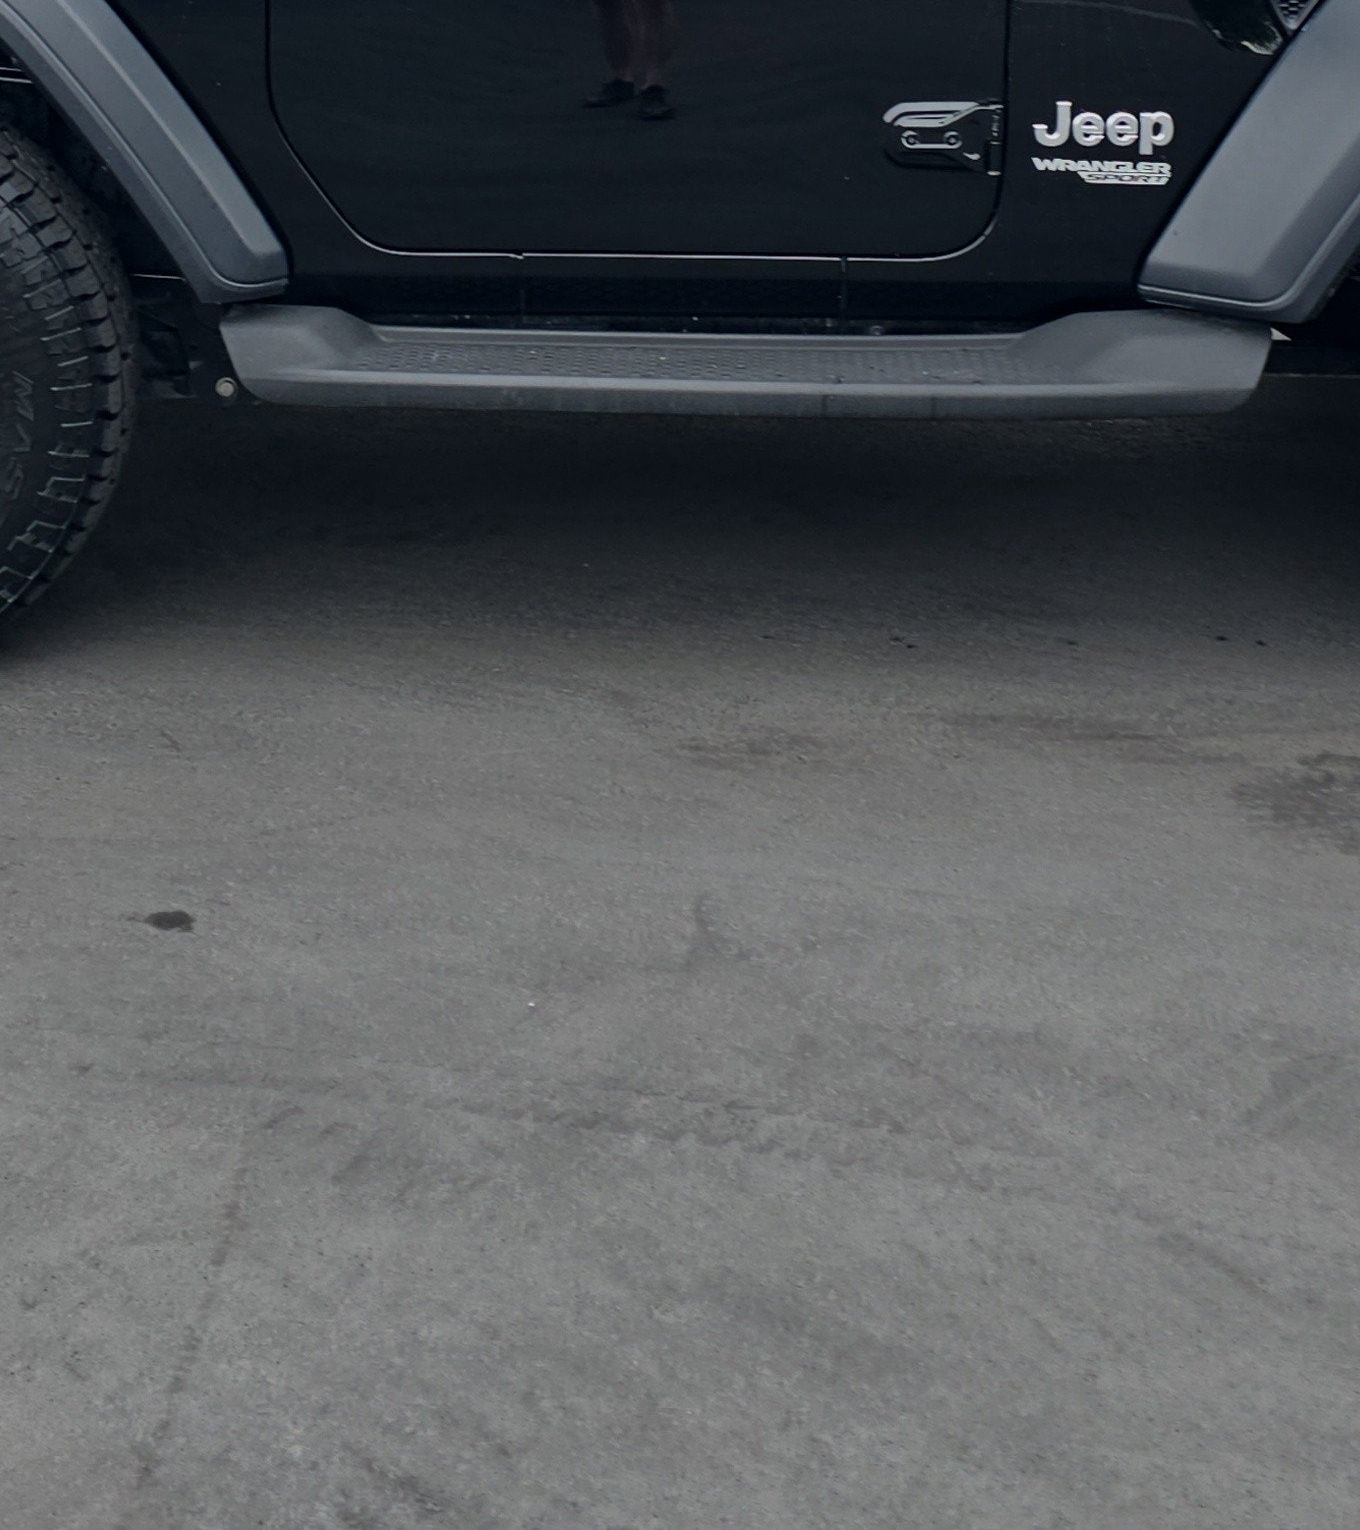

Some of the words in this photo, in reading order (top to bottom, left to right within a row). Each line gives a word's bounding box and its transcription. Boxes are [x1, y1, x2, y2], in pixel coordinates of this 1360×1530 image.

[1032, 101, 1174, 155] Jeep
[1031, 157, 1171, 176] WRANGLER
[1083, 172, 1169, 184] SPORT
